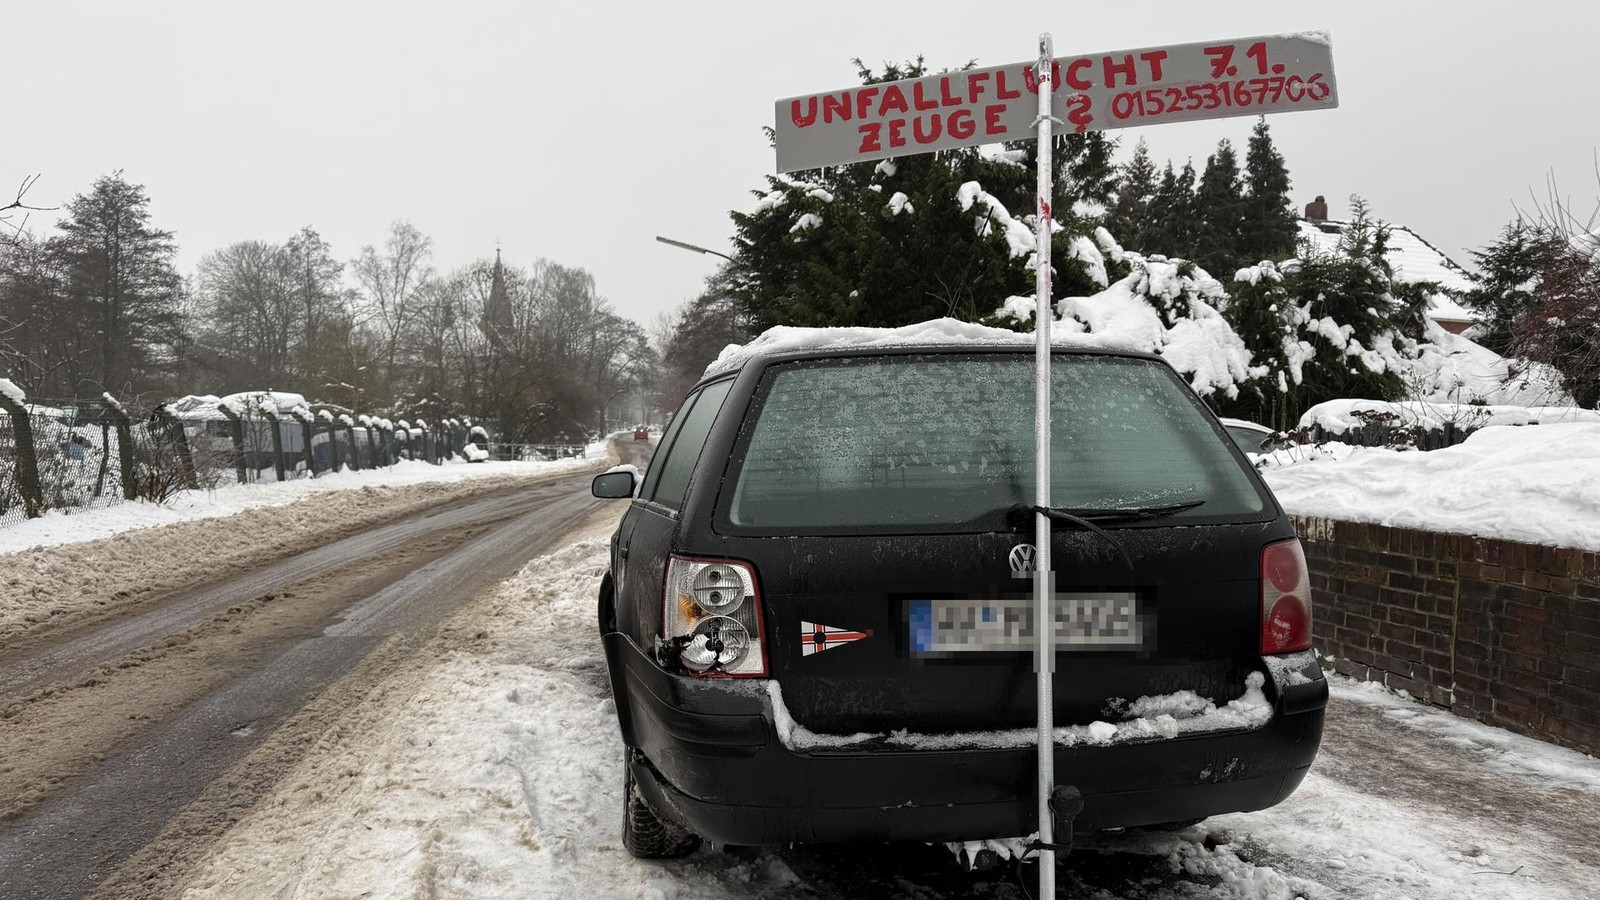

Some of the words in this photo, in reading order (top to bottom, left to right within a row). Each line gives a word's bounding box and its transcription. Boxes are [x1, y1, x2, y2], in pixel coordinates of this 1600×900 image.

[791, 50, 1168, 128] UNFALLFLUCHT
[1204, 42, 1286, 79] 7.1.
[857, 104, 1007, 153] ZEUGE
